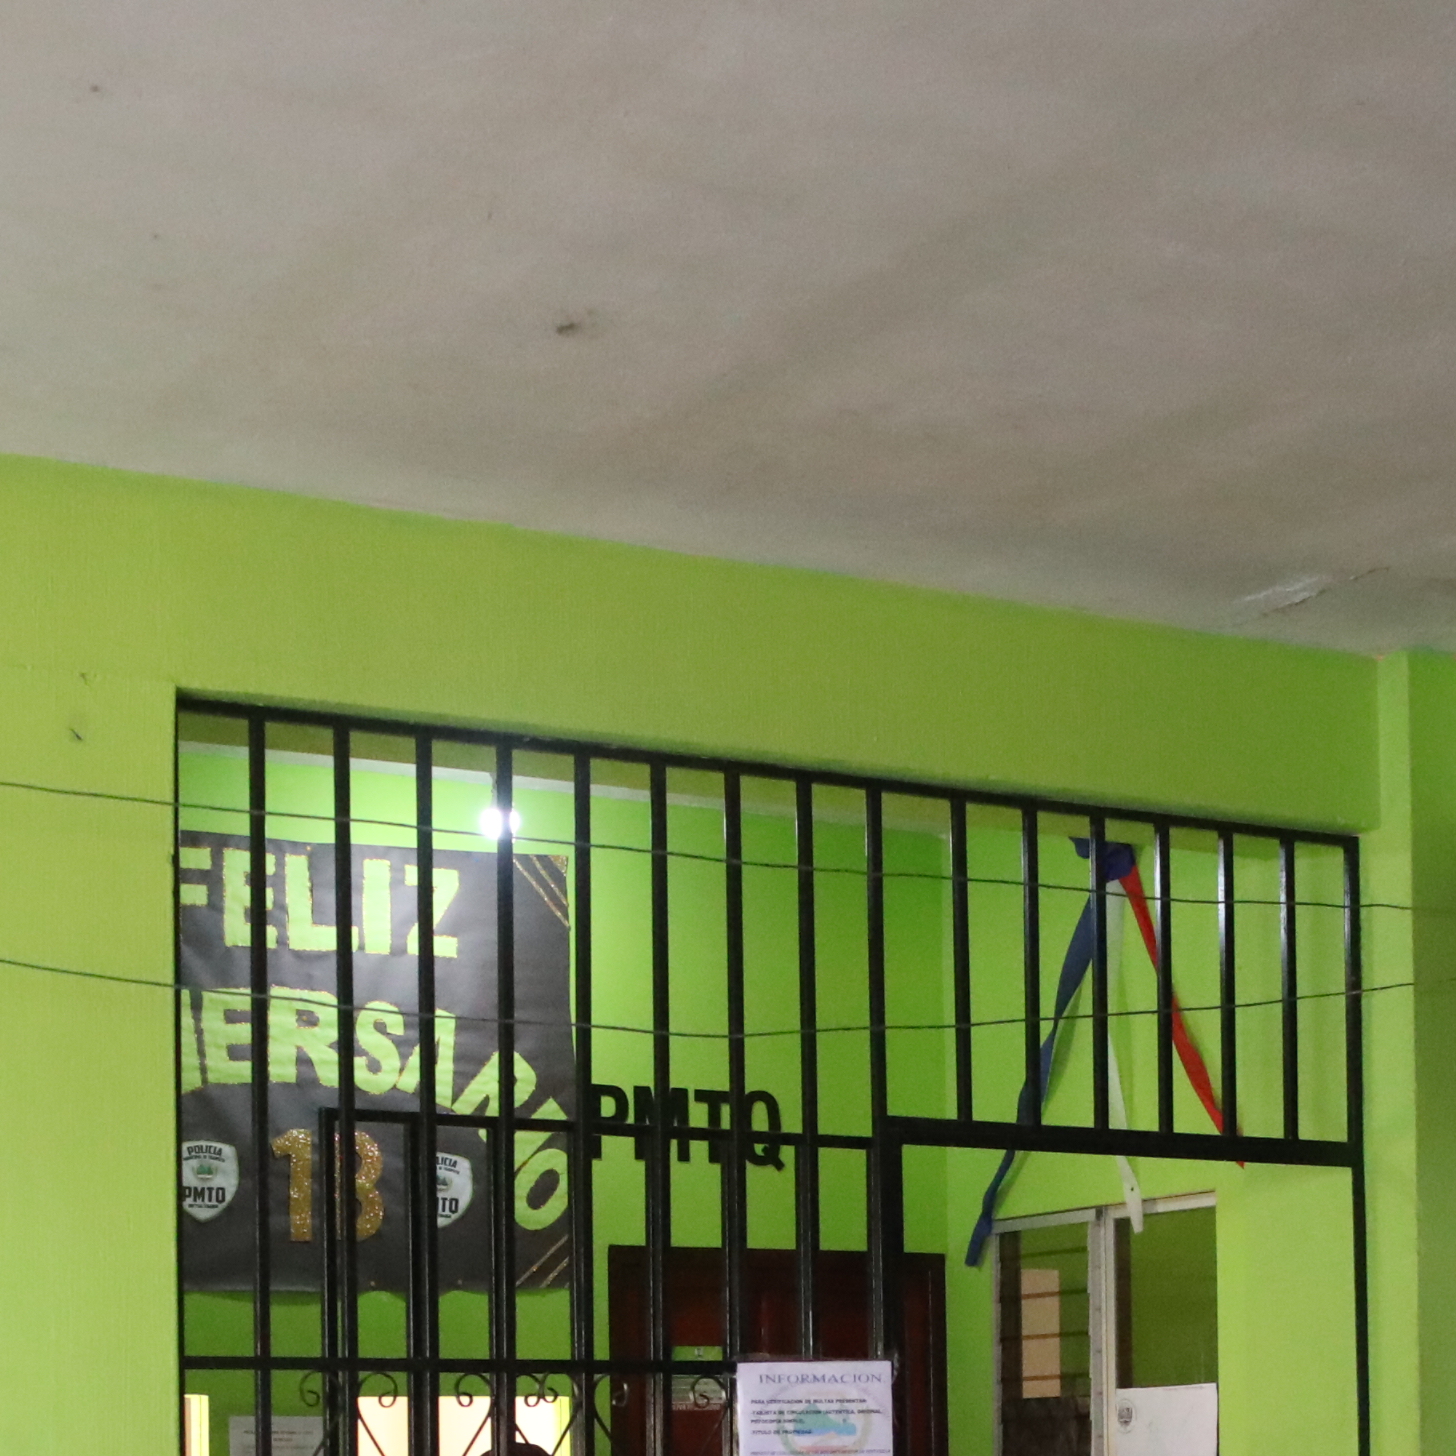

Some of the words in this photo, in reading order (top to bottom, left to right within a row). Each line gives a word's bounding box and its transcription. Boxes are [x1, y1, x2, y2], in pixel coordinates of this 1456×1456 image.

[179, 846, 460, 958] FELIZ
[186, 1144, 223, 1157] POLICIA
[591, 1083, 786, 1173] PMTQ
